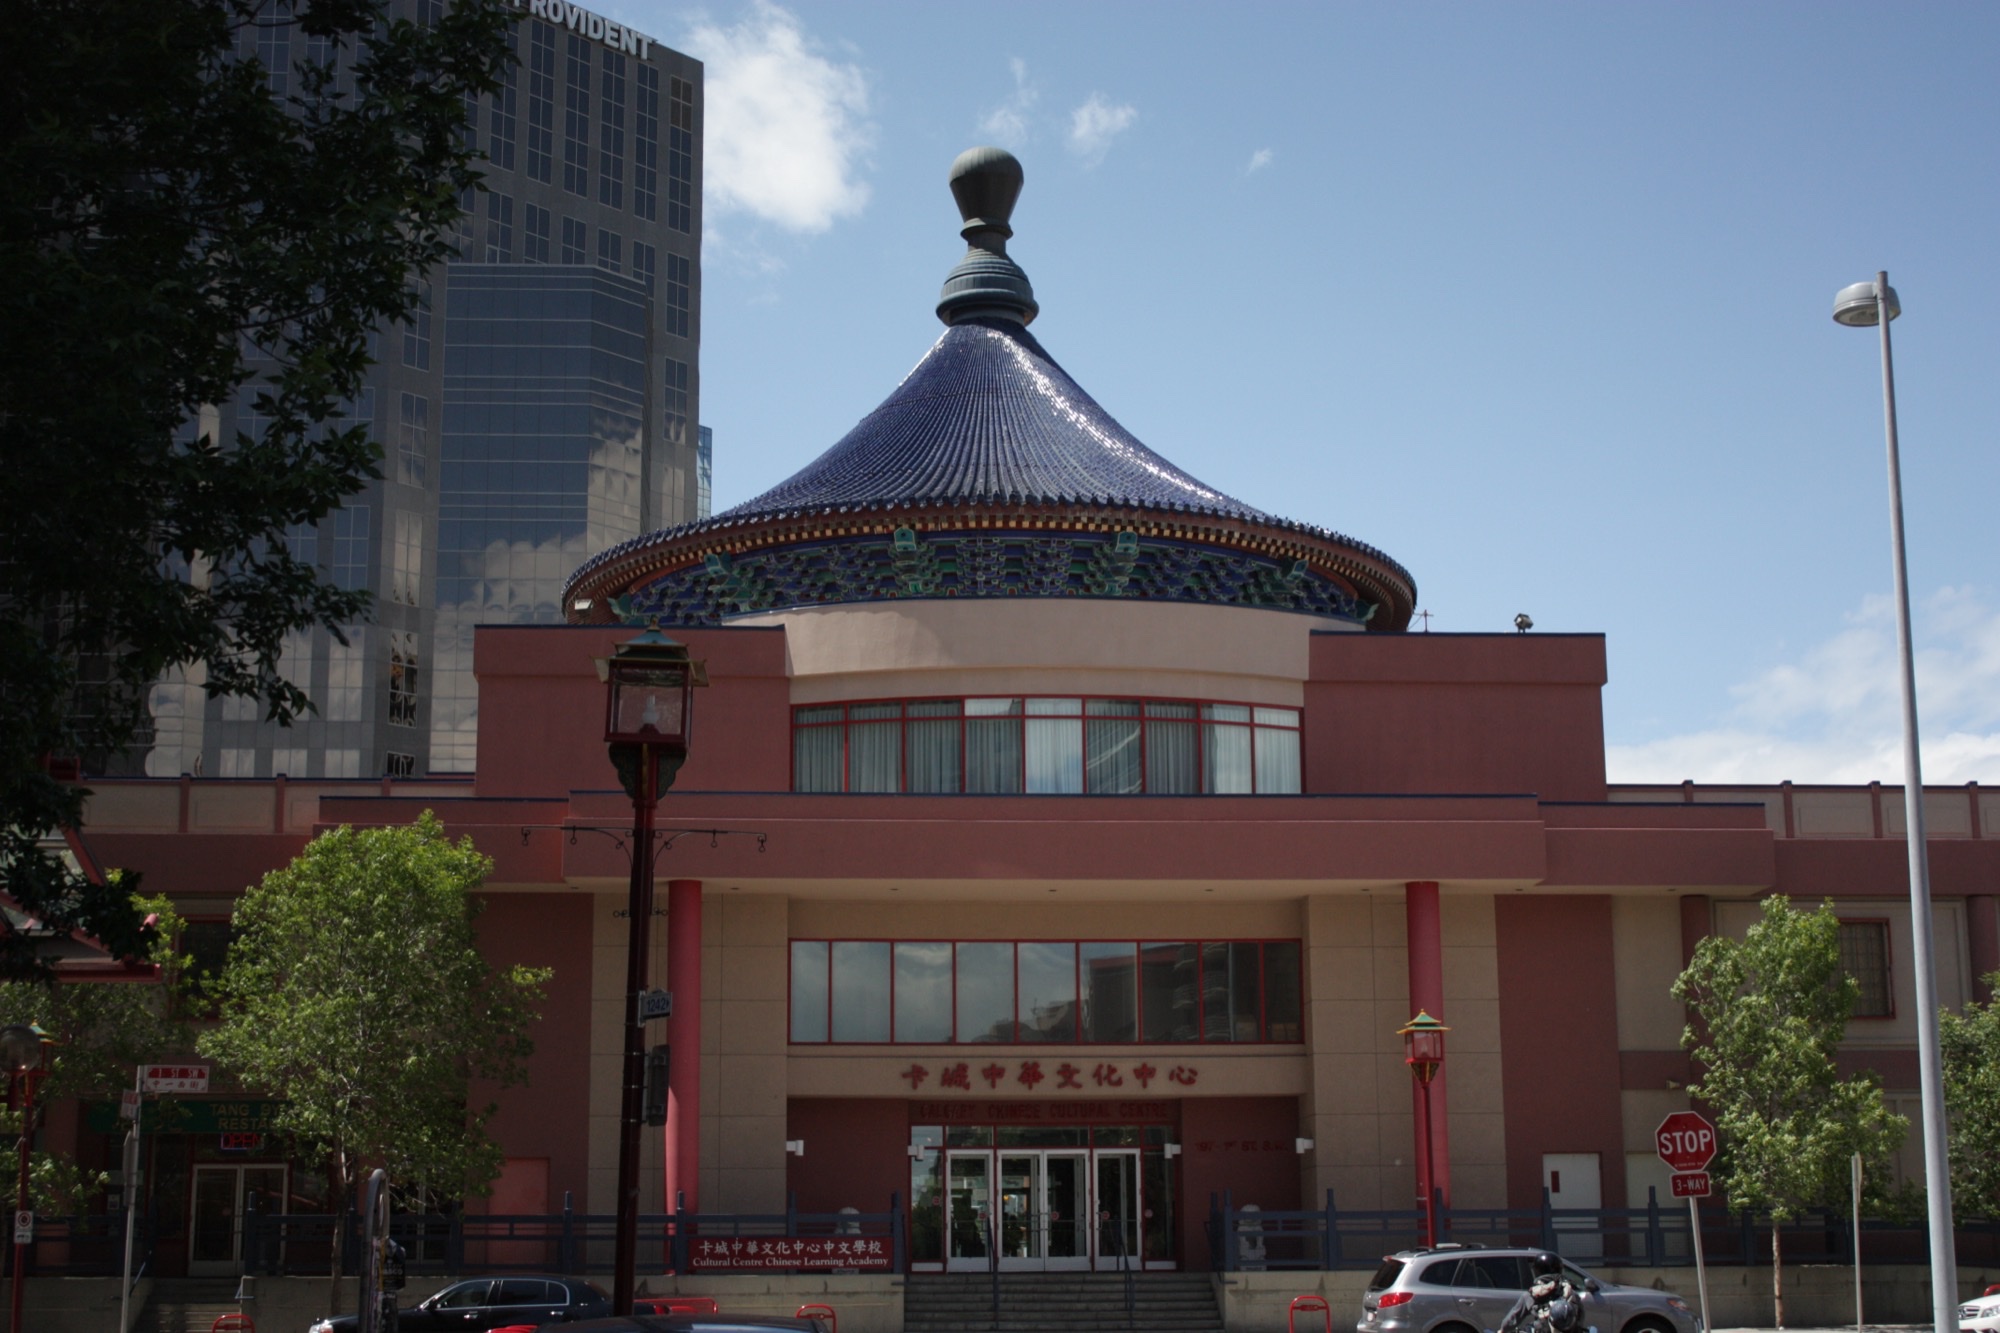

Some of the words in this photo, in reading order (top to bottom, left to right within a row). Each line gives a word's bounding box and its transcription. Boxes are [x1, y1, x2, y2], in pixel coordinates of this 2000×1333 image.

[513, 0, 653, 60] ROVIDENT
[901, 1062, 1199, 1090] 卡城中華文化中心
[209, 1103, 250, 1117] TANG
[988, 1103, 1041, 1119] CHINESE
[1049, 1103, 1110, 1118] CULTURAL
[1119, 1102, 1168, 1118] CENTRE
[223, 1133, 261, 1148] OPEN
[1660, 1130, 1712, 1155] STOP
[1675, 1177, 1706, 1192] 3-WAY
[699, 1239, 883, 1256] 卡城中華文化中心中文學校
[692, 1257, 731, 1267] Cultural
[732, 1257, 764, 1267] Centre
[765, 1257, 802, 1267] Chinese
[804, 1257, 844, 1267] Learning
[845, 1256, 889, 1267] Academy
